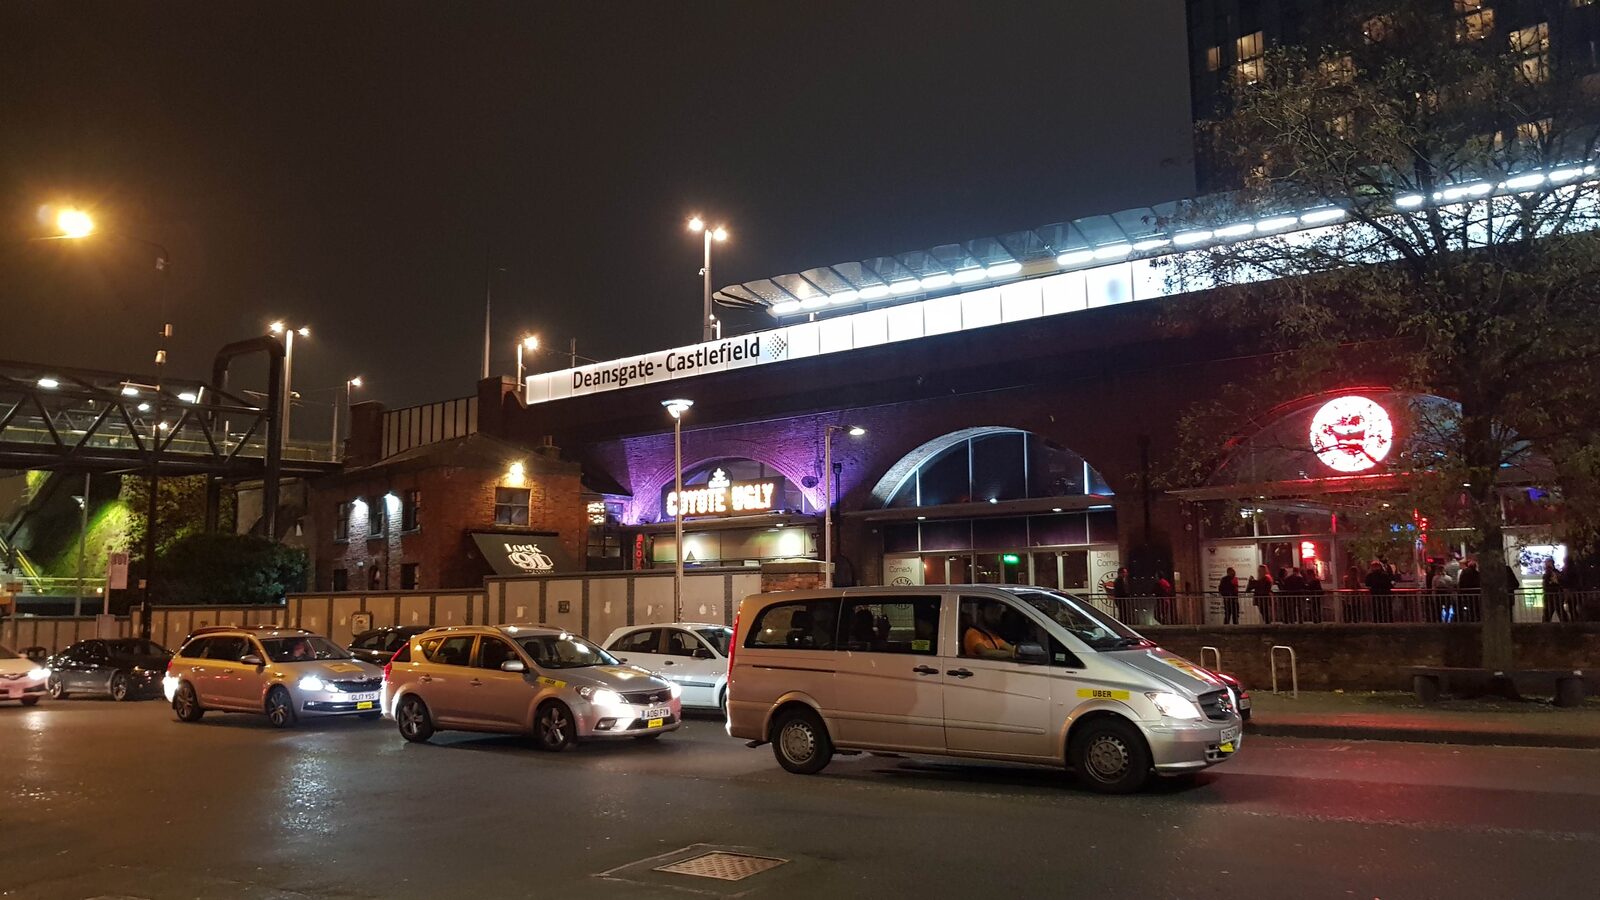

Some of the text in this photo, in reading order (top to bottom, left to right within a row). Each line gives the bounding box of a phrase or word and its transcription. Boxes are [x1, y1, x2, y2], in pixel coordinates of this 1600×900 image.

[573, 361, 654, 390] Deansgate
[665, 337, 760, 373] Castlefield
[666, 483, 774, 517] COYOTE UGLY
[889, 565, 912, 573] Comedy
[1092, 690, 1112, 698] UBER
